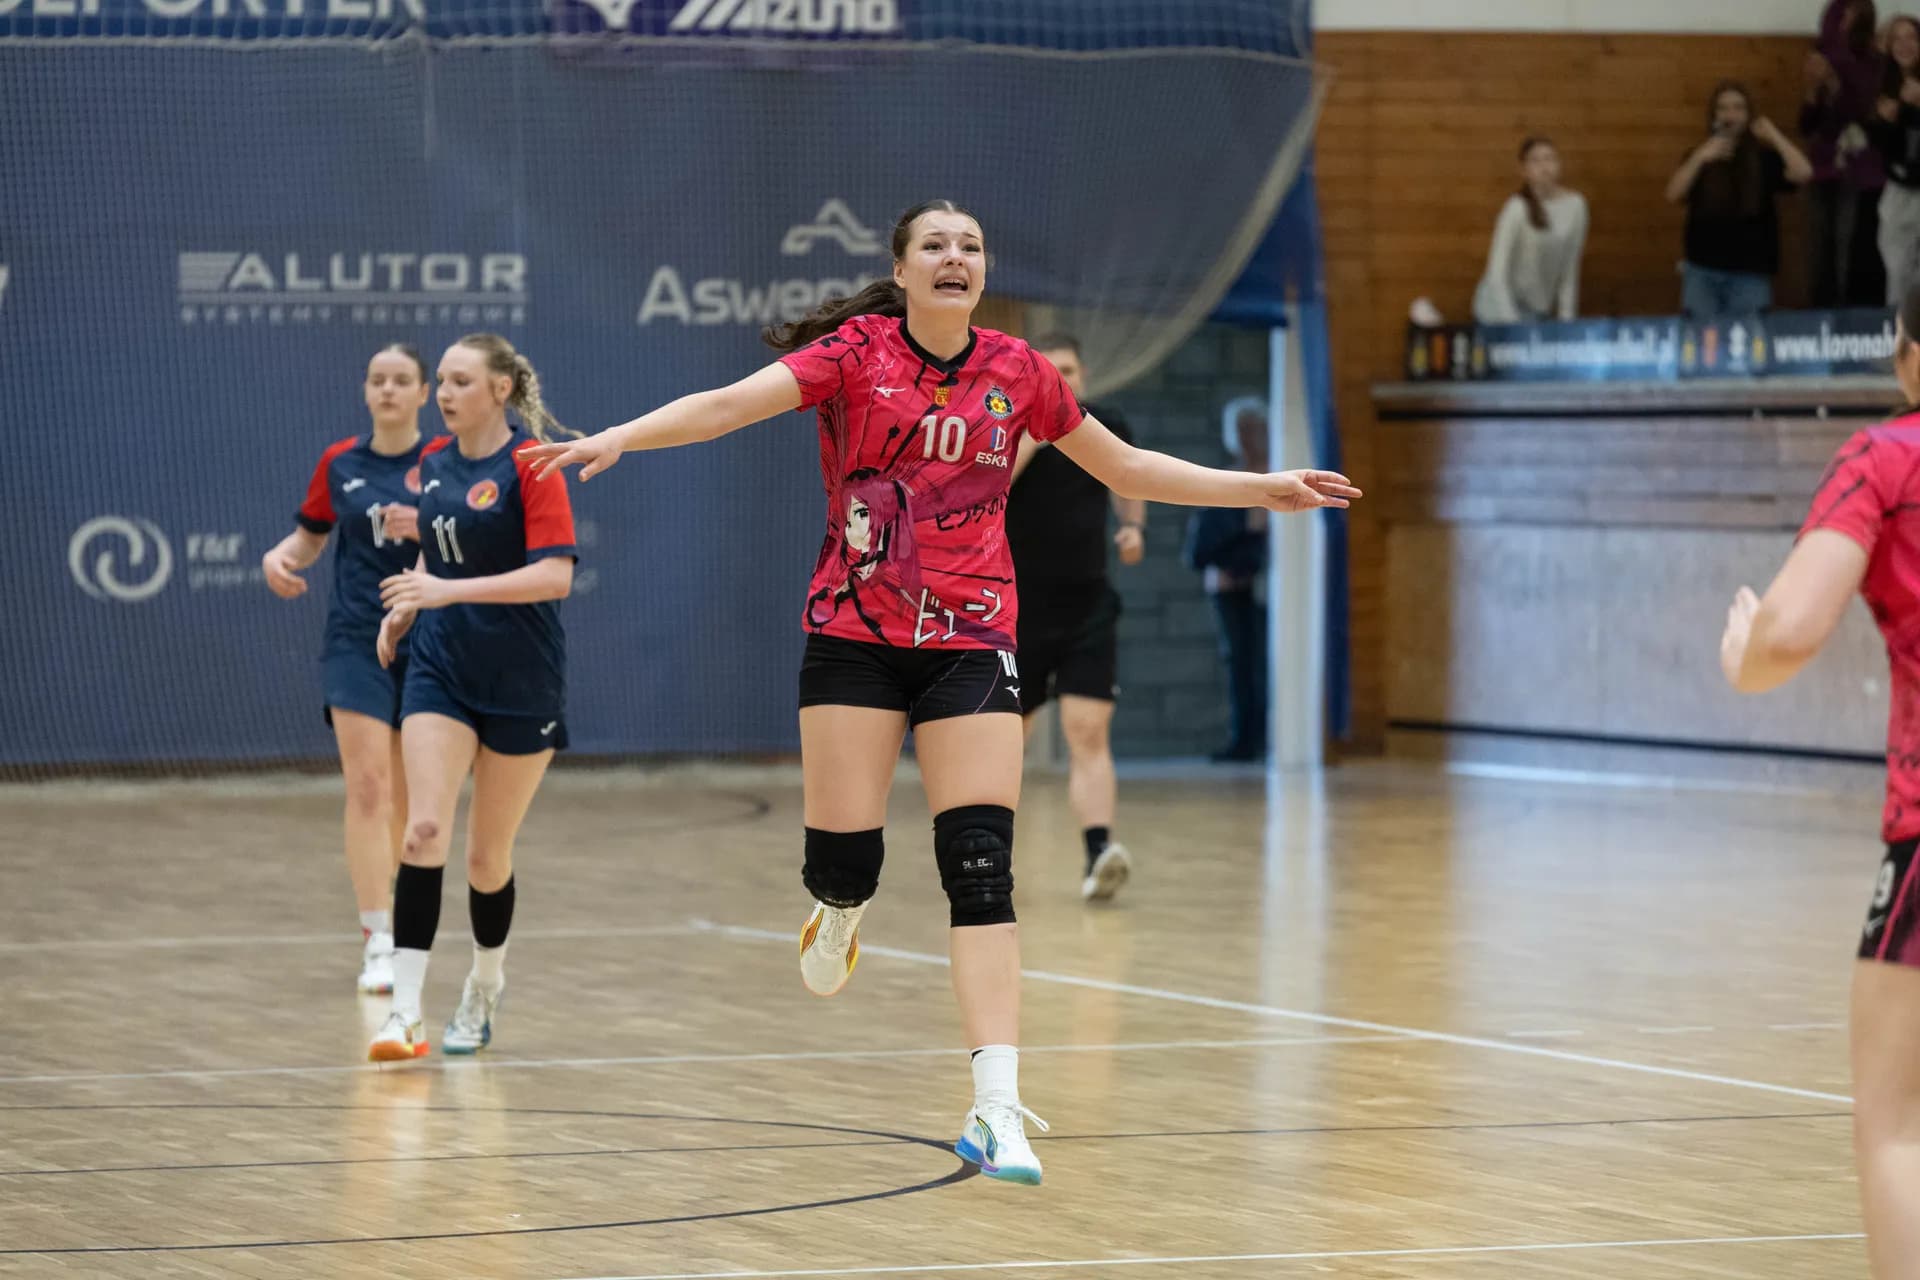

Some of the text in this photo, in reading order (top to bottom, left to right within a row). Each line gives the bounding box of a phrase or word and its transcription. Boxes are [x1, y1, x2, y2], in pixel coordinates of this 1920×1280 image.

[227, 252, 526, 290] ALUTOR
[919, 414, 967, 463] 10
[975, 451, 1008, 469] ESKA
[431, 515, 464, 564] 11
[997, 650, 1019, 679] 10
